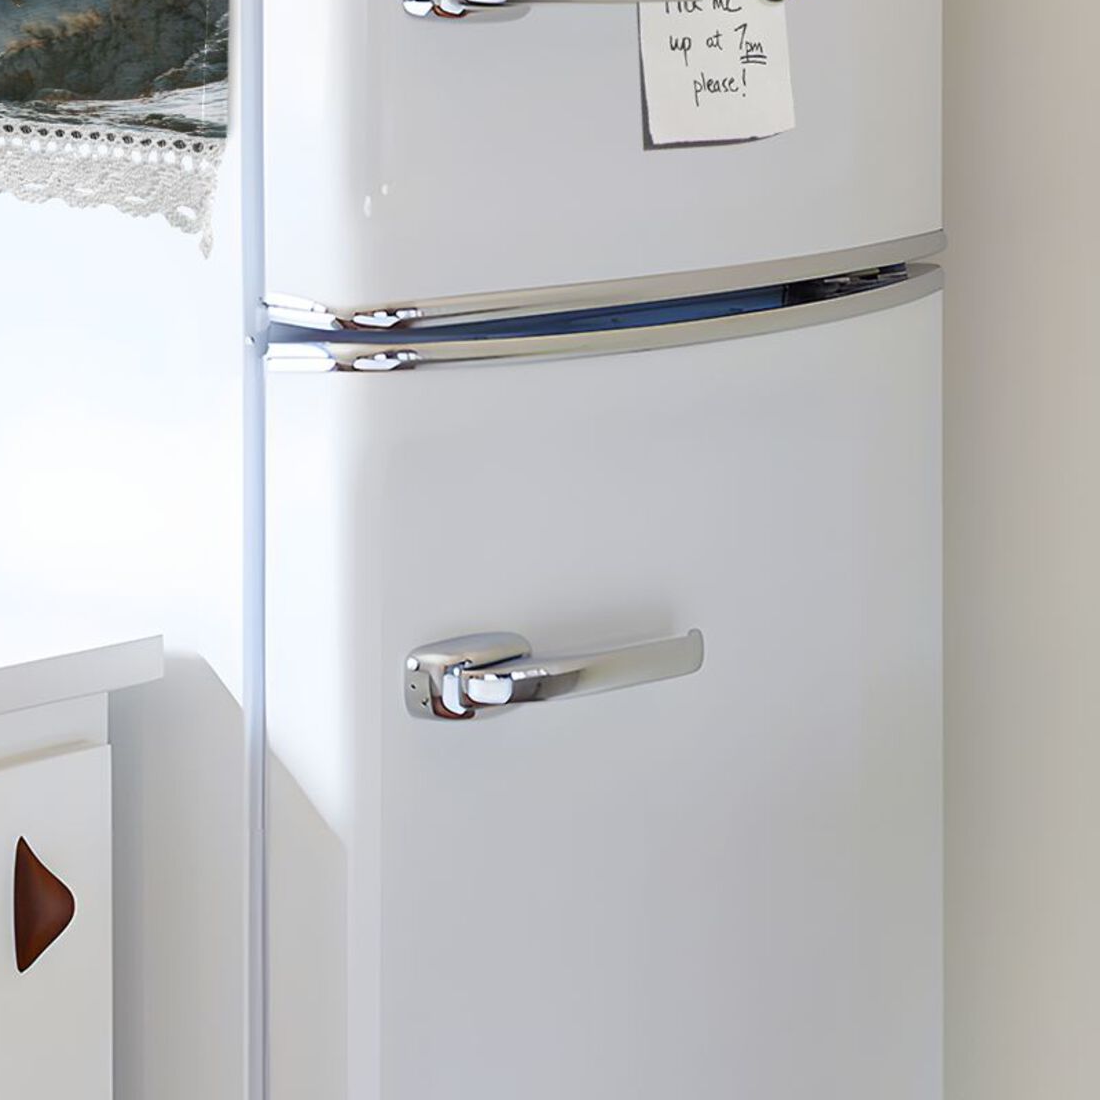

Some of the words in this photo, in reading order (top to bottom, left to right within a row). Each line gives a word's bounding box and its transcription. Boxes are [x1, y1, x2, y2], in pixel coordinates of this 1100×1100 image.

[669, 35, 692, 66] up
[706, 30, 723, 50] at
[693, 68, 746, 107] please!
